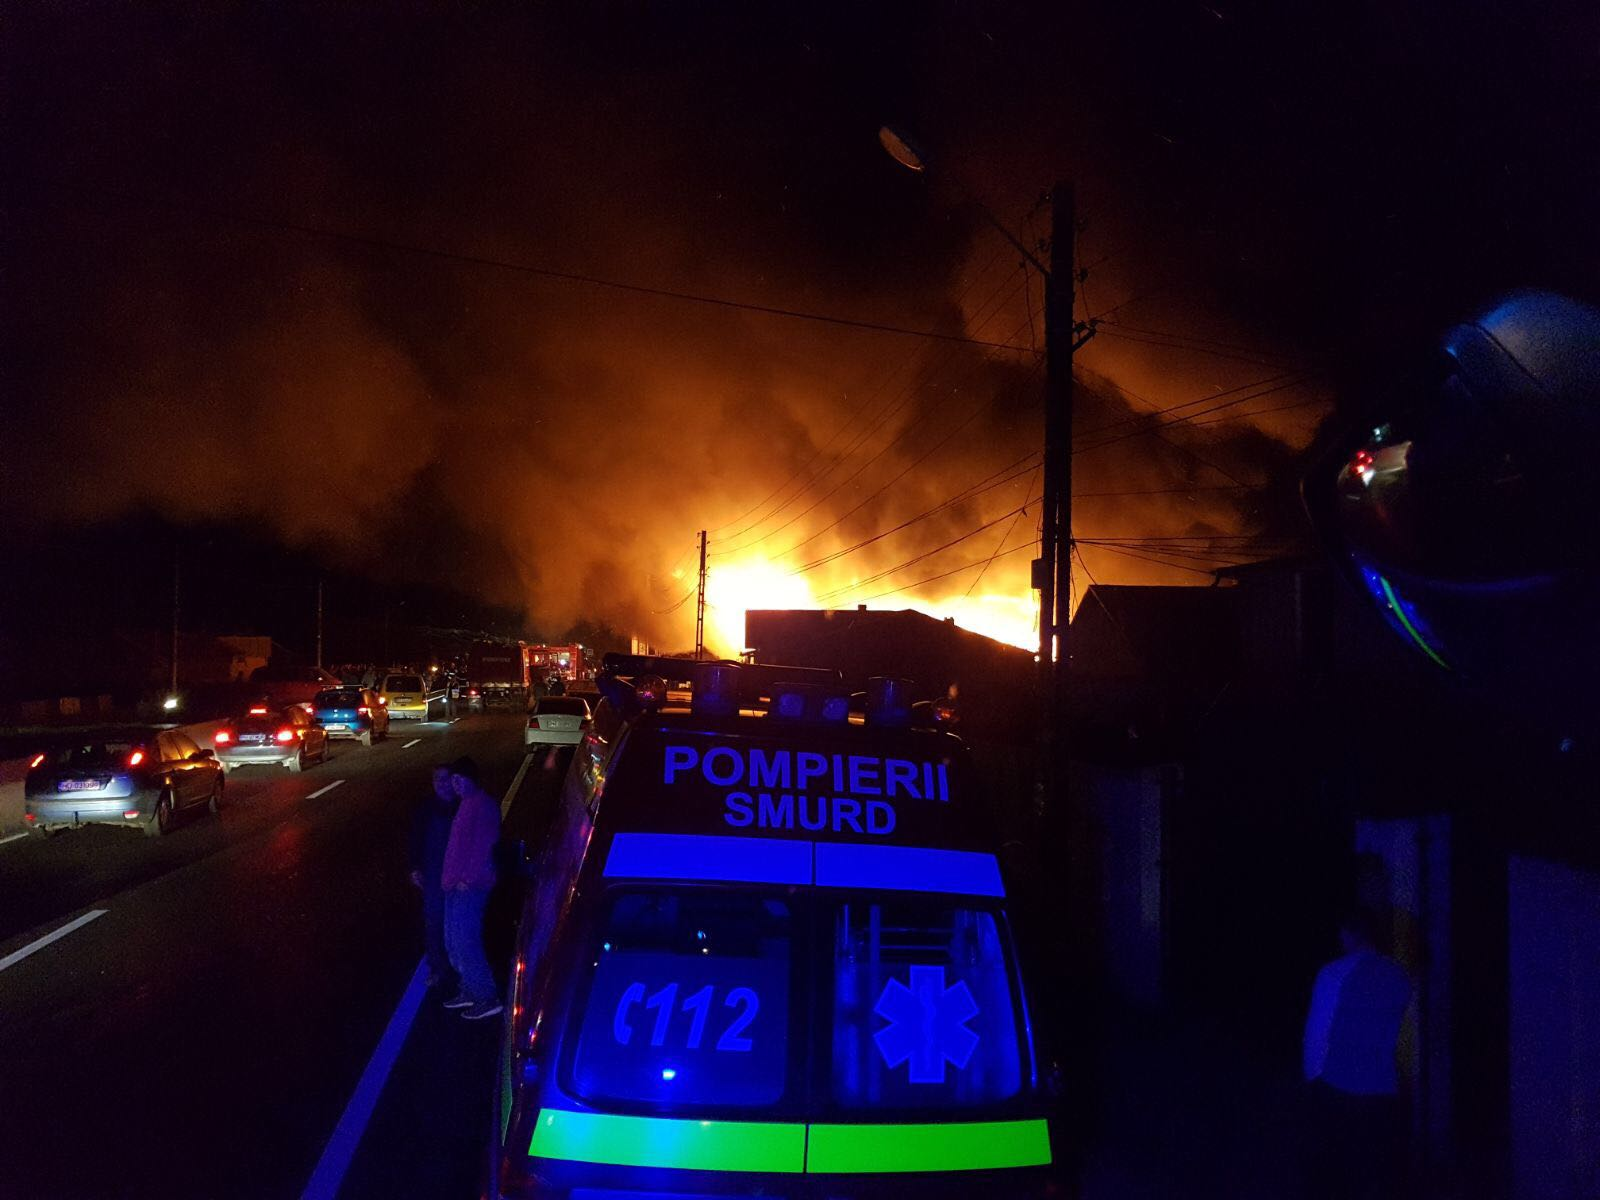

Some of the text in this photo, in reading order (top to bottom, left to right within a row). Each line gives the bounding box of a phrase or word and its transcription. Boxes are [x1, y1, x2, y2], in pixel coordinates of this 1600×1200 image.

[664, 745, 949, 802] POMPIERII
[723, 791, 897, 835] SMURD
[646, 982, 760, 1052] 112
